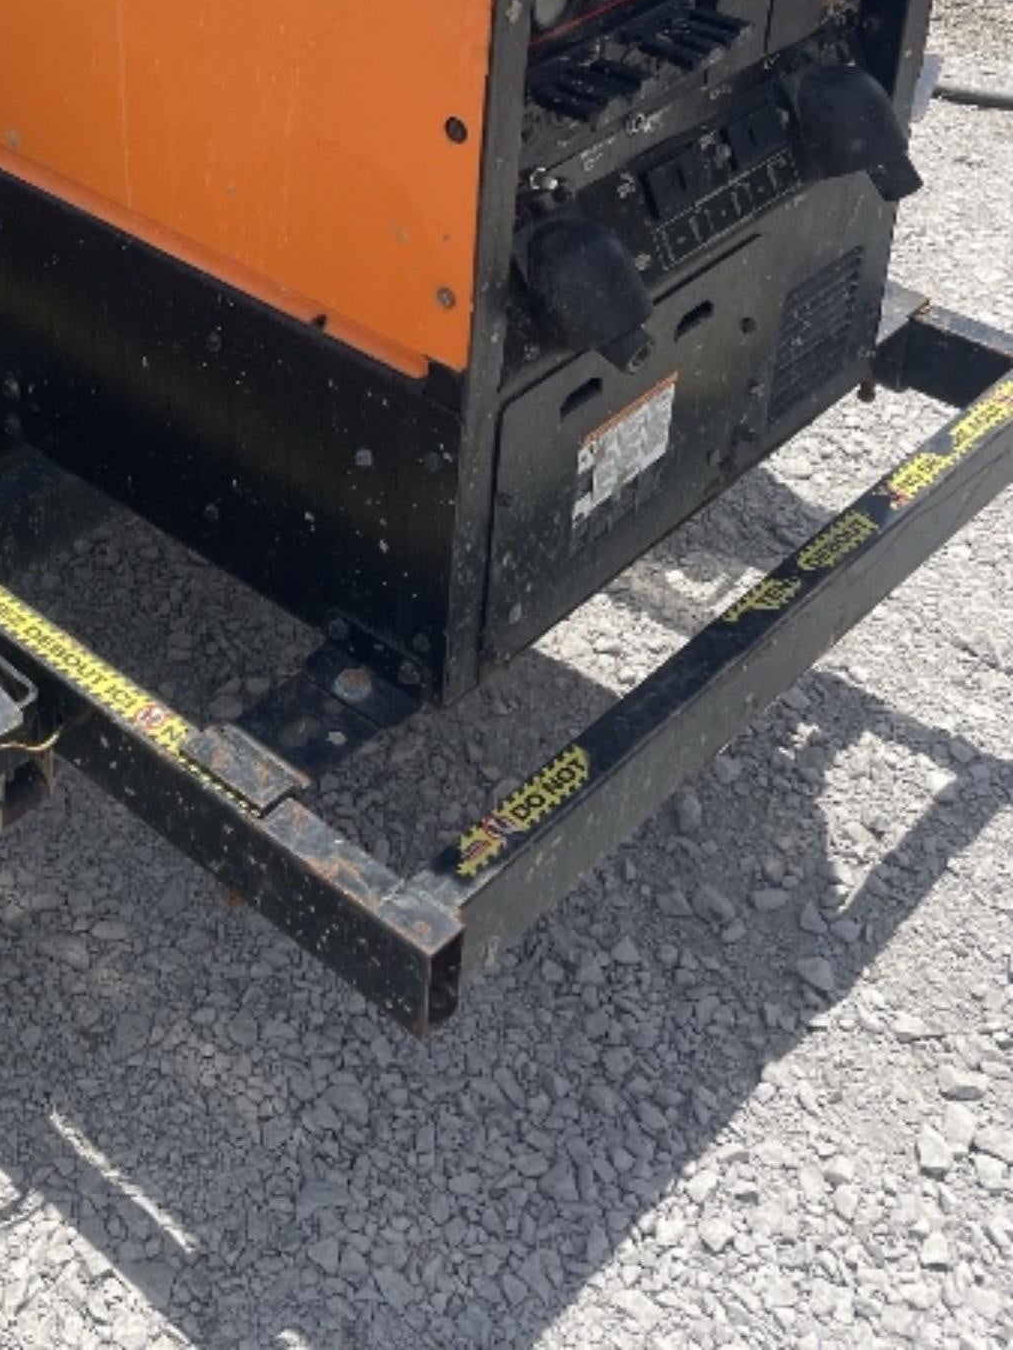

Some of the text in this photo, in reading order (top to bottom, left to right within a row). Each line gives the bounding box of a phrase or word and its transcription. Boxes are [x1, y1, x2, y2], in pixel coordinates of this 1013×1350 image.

[23, 623, 109, 685] DEBOUT
[509, 758, 586, 822] DO NOT
